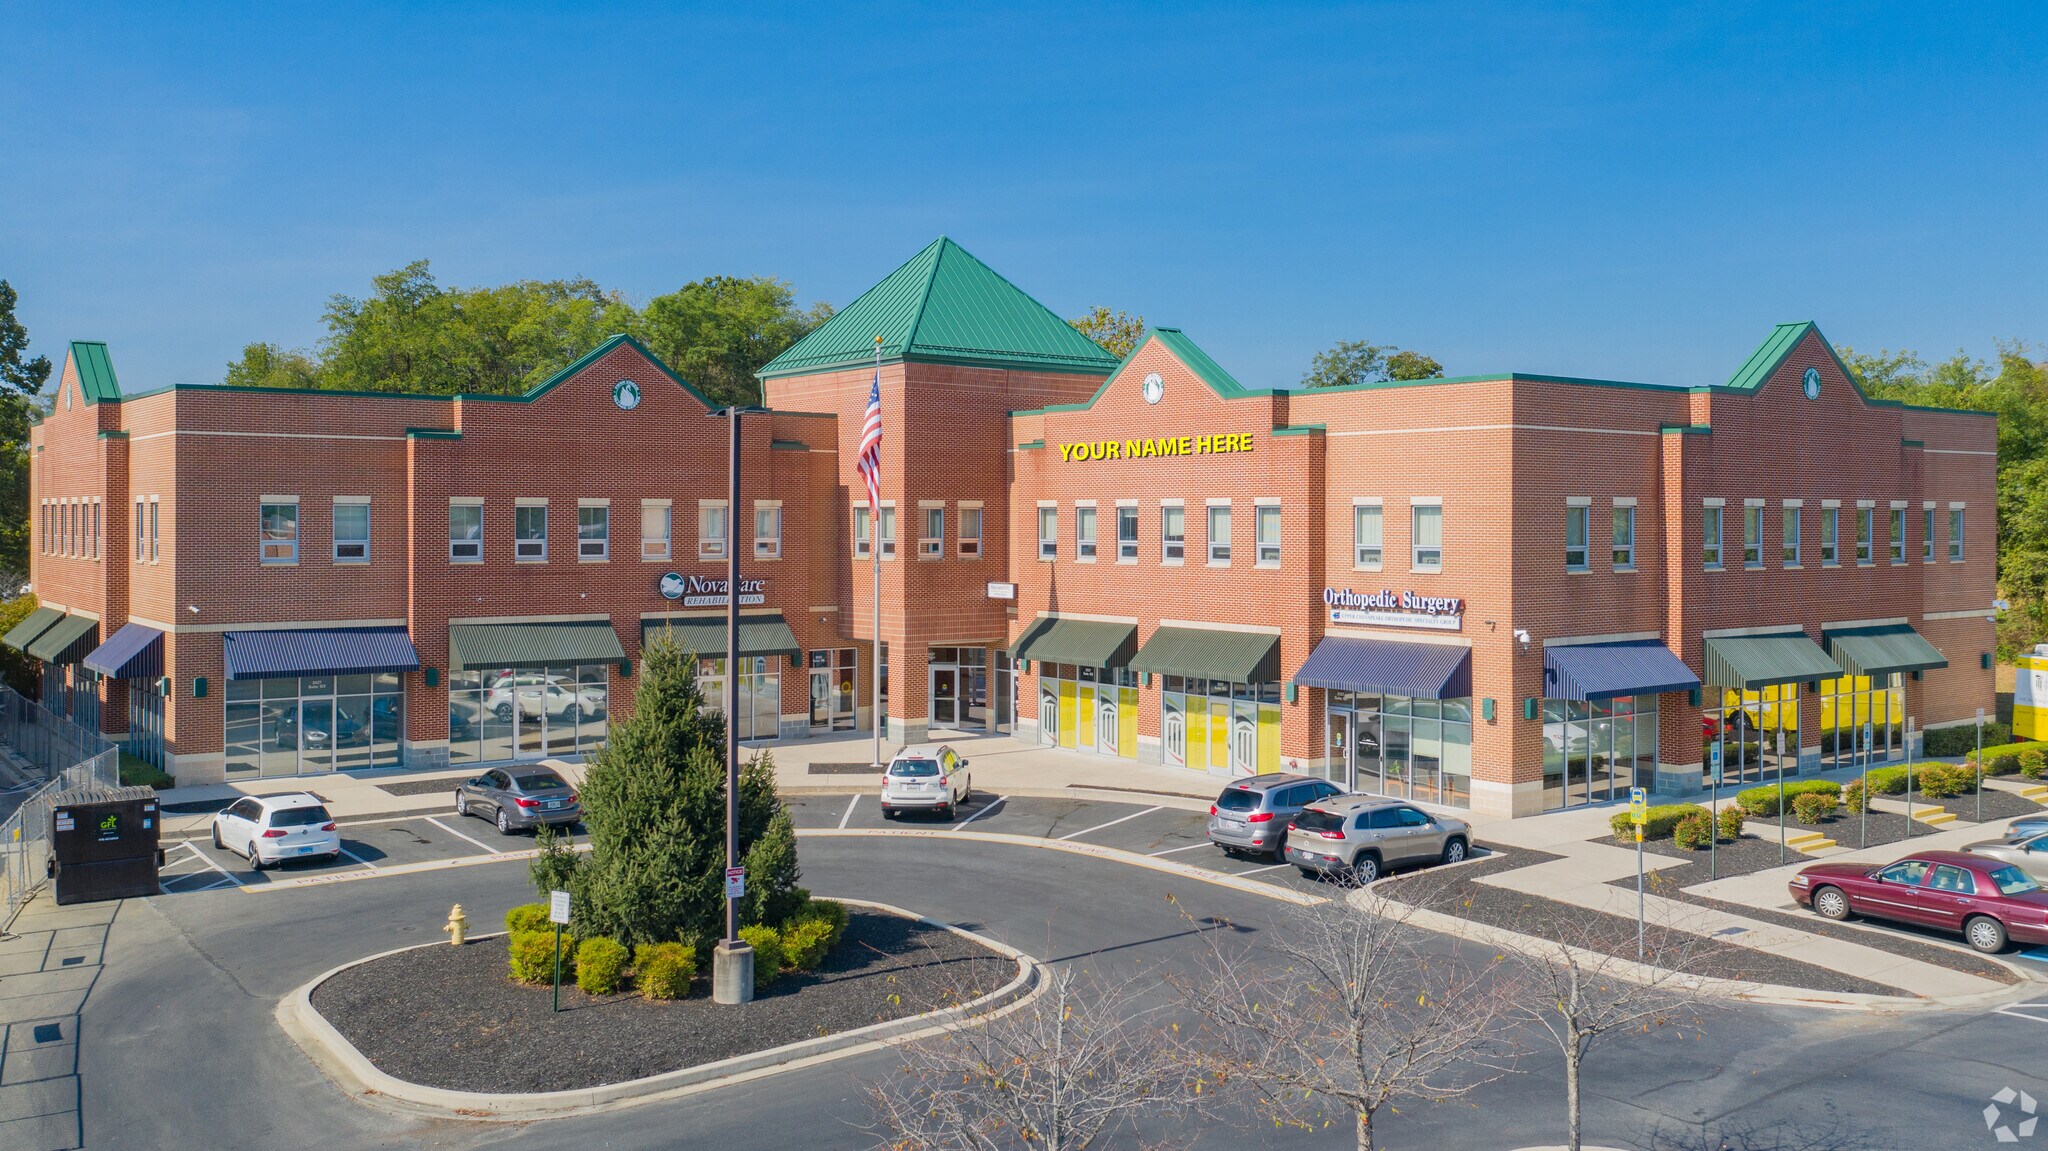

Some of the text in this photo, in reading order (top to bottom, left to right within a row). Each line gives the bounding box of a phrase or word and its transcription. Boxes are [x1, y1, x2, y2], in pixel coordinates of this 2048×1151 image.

[686, 575, 766, 594] Novaare
[687, 596, 762, 605] REHABILTION
[1323, 587, 1460, 615] Orthopedic Surgery
[100, 820, 117, 829] GFL
[296, 870, 378, 884] PATIENT
